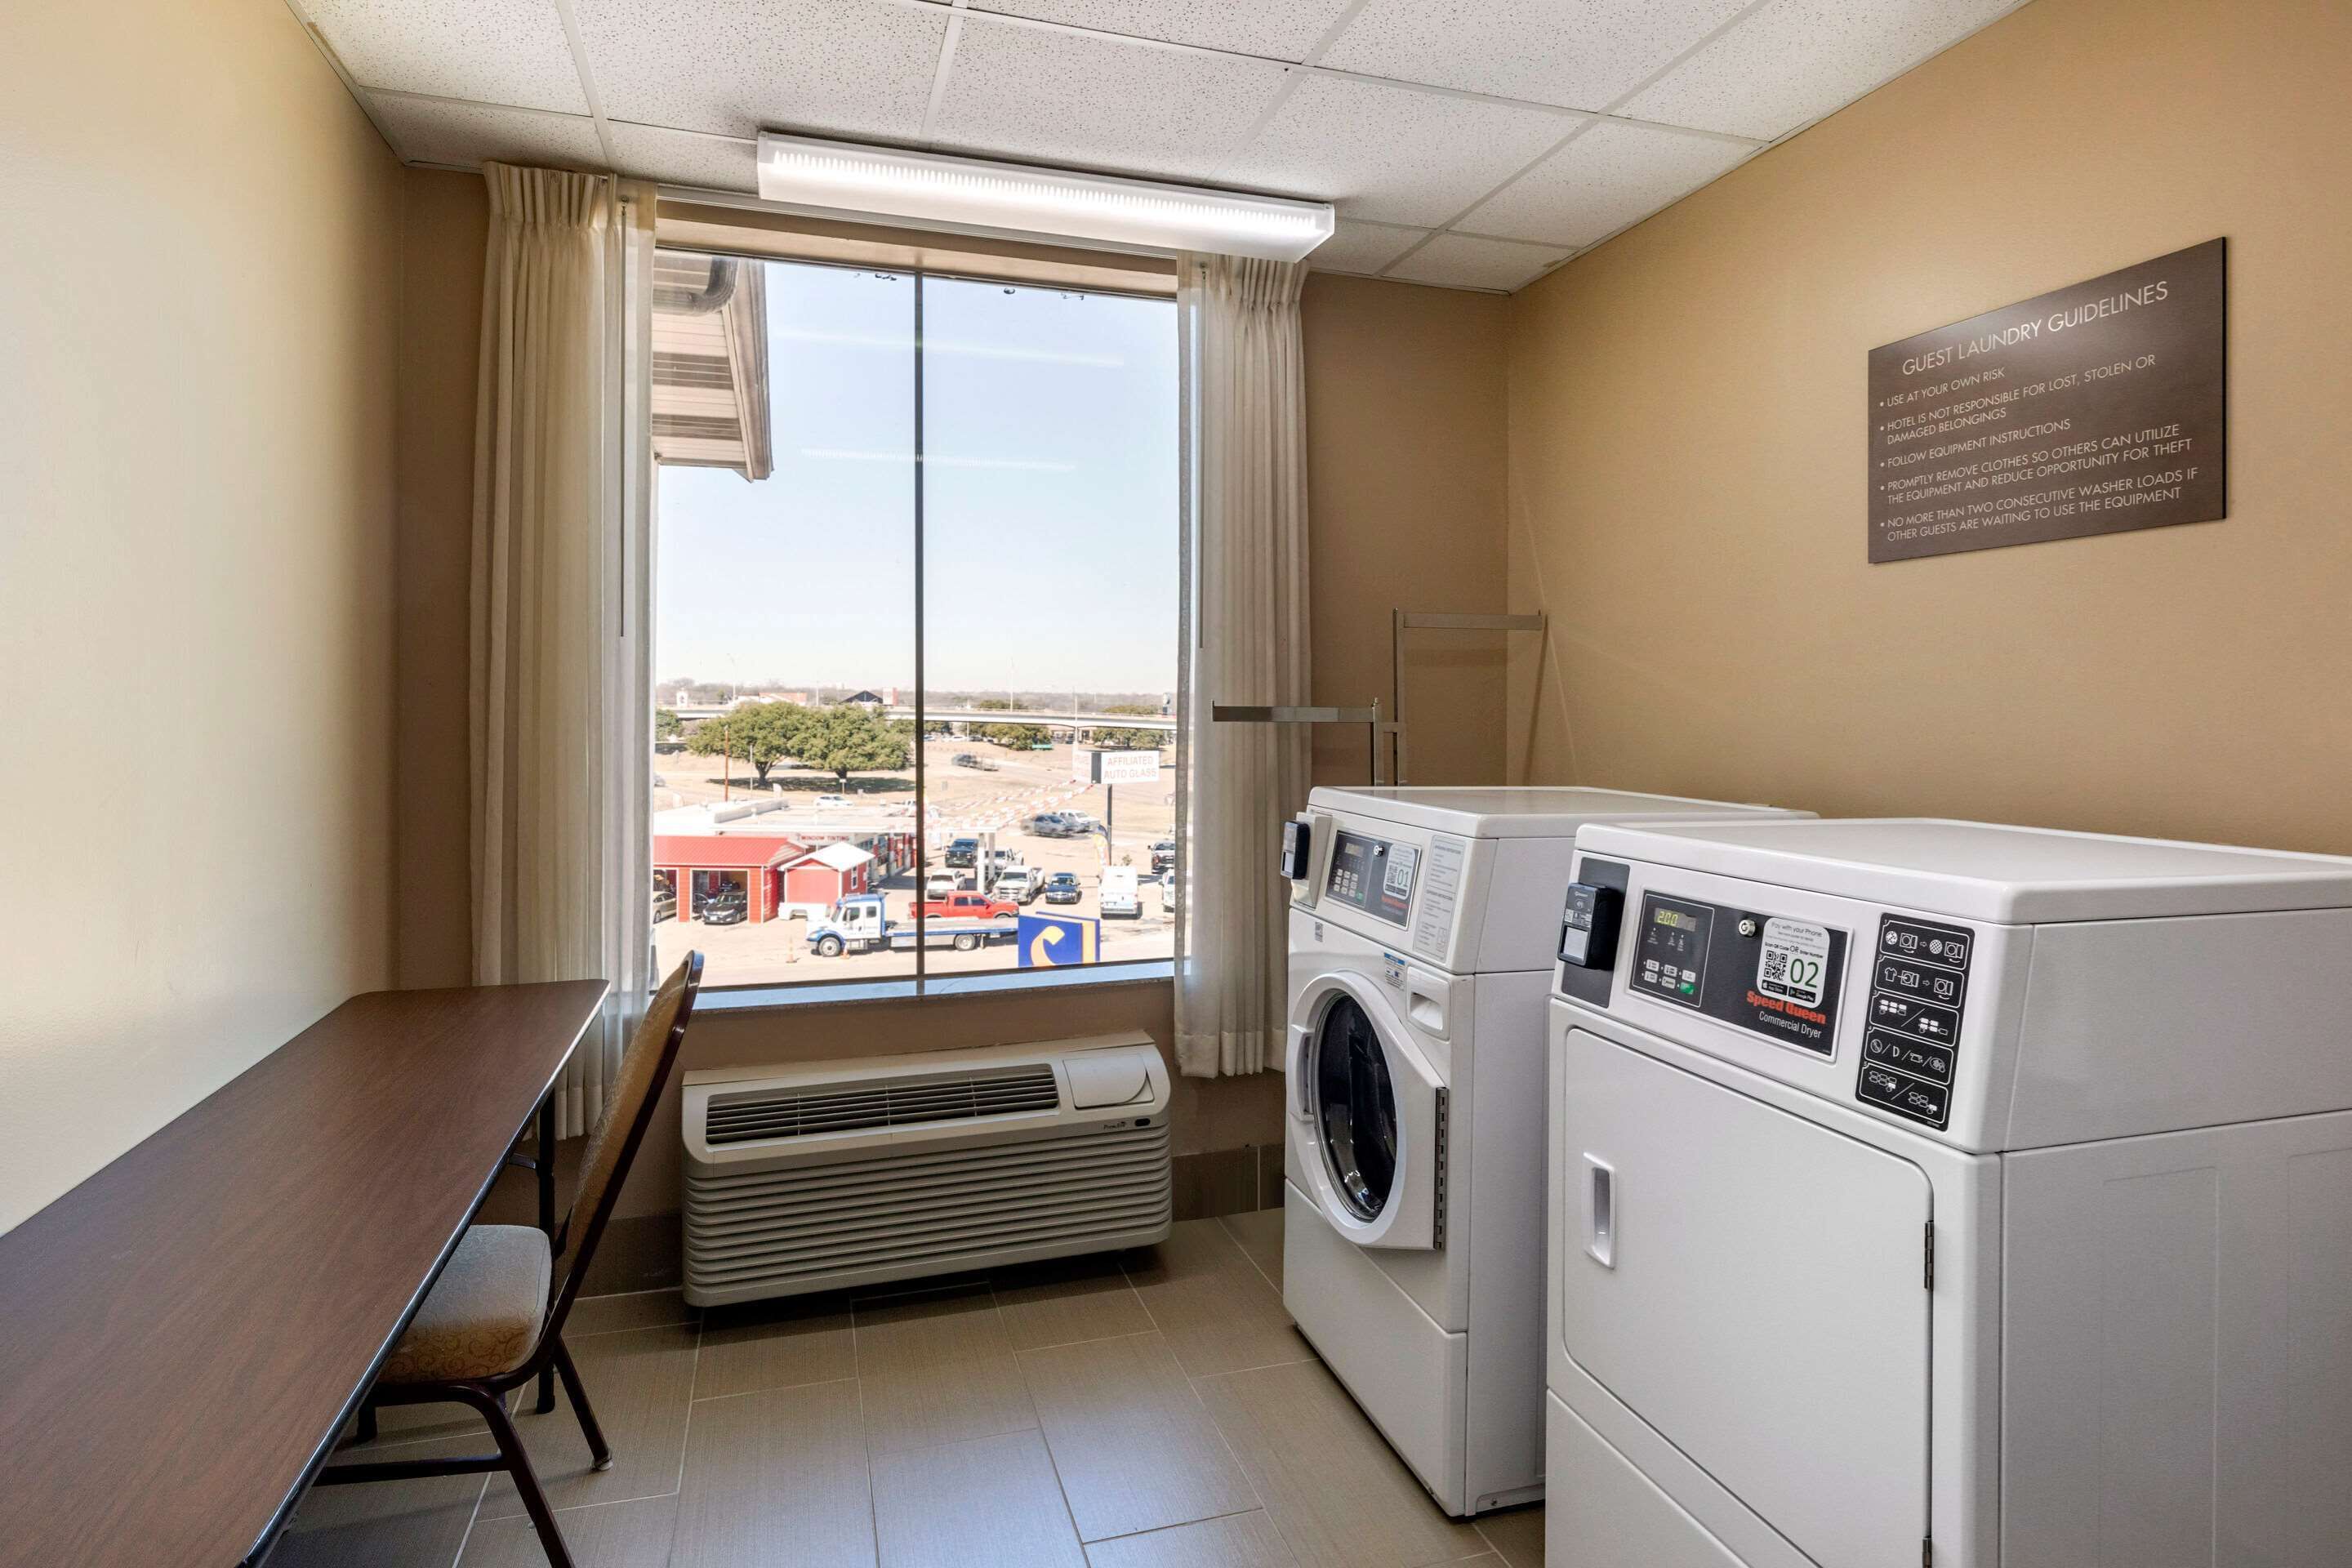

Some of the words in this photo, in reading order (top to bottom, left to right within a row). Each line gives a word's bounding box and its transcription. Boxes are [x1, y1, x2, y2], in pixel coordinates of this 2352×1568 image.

[1902, 346, 1953, 376] GUEST
[1958, 319, 2042, 360] LAUNDRY
[2047, 281, 2168, 332] GUIDELINES
[1886, 394, 1904, 407] USE
[1907, 390, 1918, 403] AT
[1921, 383, 1948, 399] YOUR
[1950, 374, 1980, 390] OWN
[1983, 367, 2005, 382] RISK
[1887, 414, 1915, 431] HOTEL
[1918, 412, 1926, 424] IS
[1928, 407, 1950, 421] NOT
[1953, 389, 2020, 415] RESPONSIBLE
[2023, 382, 2046, 398] FOR
[2049, 373, 2079, 391] LOST,
[2084, 360, 2132, 382] STOLEN
[2136, 354, 2156, 368] OR
[1887, 425, 1936, 444] DAMAGED
[1939, 408, 2007, 433] BELONGINGS
[1887, 450, 1927, 468] FOLLOW
[1929, 437, 1986, 459] EQUIPMENT
[1989, 418, 2071, 446] INSTRUCTIONS
[1887, 473, 1934, 491] PROMPTLY
[1936, 464, 1979, 482] REMOVE
[1981, 454, 2029, 473] CLOTHES
[2032, 450, 2049, 463] SO
[2051, 440, 2098, 459] OTHERS
[2101, 434, 2131, 449] CAN
[2135, 424, 2180, 443] UTILIZE
[1887, 493, 1904, 505] THE
[1907, 481, 1962, 501] EQUIPMENT
[1964, 477, 1989, 491] AND
[1992, 468, 2034, 485] REDUCE
[2037, 452, 2120, 477] OPPORTUNITY
[2123, 447, 2149, 462] FOR
[2153, 438, 2193, 457] THEFT
[1887, 517, 1904, 528] NO
[1905, 511, 1935, 525] MORE
[1937, 506, 1965, 520] THAN
[1967, 501, 1993, 514] TWO
[1996, 488, 2075, 511] CONSECUTIVE
[2078, 478, 2133, 497] WASHER
[2137, 470, 2183, 488] LOADS
[2187, 467, 2198, 480] IF
[1887, 528, 1918, 542] OTHER
[1920, 522, 1958, 537] GUESTS
[1959, 518, 1980, 531] ARE
[1981, 510, 2032, 527] WAITING
[2034, 507, 2051, 519] TO
[2053, 503, 2076, 516] USE
[2078, 499, 2101, 512] THE
[2105, 487, 2181, 510] EQUIPMENT
[1104, 769, 1127, 779] AUTO
[1129, 768, 1156, 778] GLASS
[1107, 755, 1154, 766] AFFILIATED
[1397, 869, 1410, 888] 01
[1789, 958, 1817, 988] 02
[1746, 990, 1784, 1012] Speed
[1785, 1002, 1827, 1024] Queen
[1758, 1011, 1800, 1031] Commercial
[1801, 1023, 1822, 1039] Dryer
